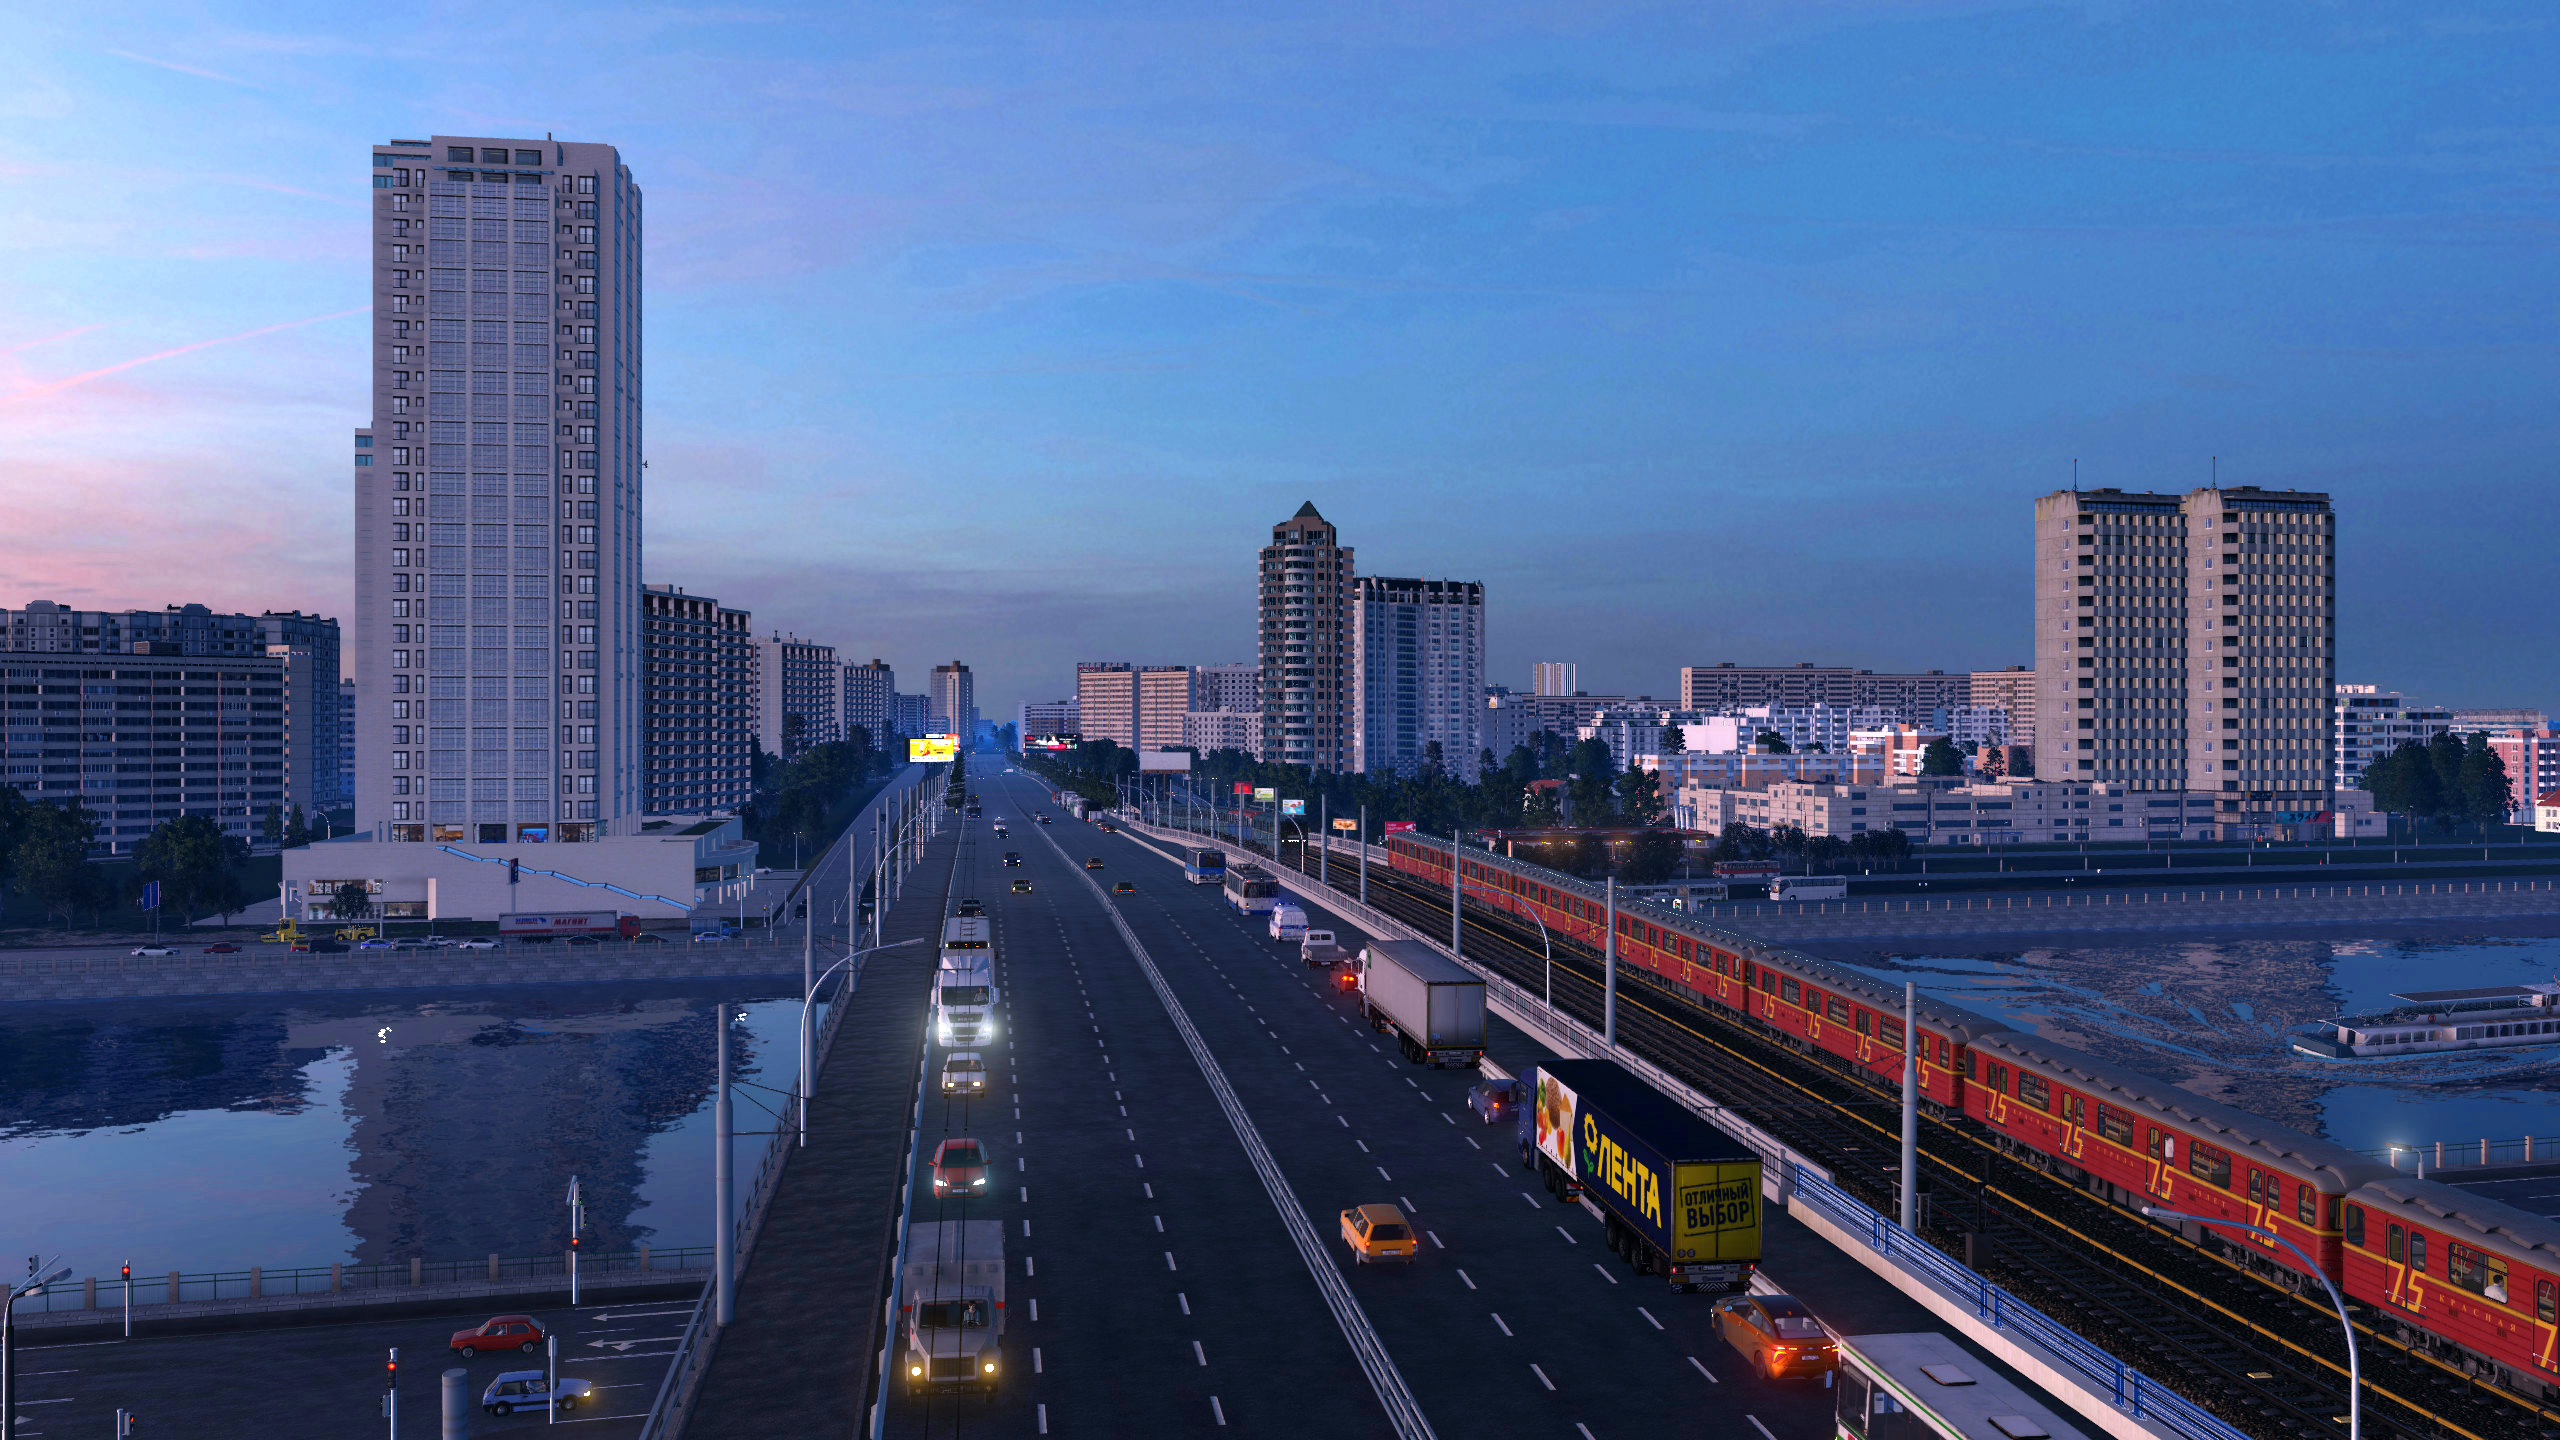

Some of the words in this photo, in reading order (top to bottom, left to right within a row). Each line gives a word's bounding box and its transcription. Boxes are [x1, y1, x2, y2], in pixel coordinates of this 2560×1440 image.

[553, 917, 588, 926] МАГНИТ
[1763, 992, 1775, 1019] 75
[1806, 1011, 1821, 1039] 75
[1856, 1030, 1872, 1063] 75
[1987, 1088, 2007, 1124] 75
[2062, 1119, 2084, 1159] 75
[1597, 1133, 1662, 1229] ЛЕНТА
[1685, 1182, 1749, 1207] ОТЛИЧНЫЙ
[2147, 1156, 2173, 1200] 75
[1687, 1201, 1749, 1229] ВЫБОР
[2247, 1200, 2278, 1249] 75
[2387, 1258, 2424, 1314] 75
[2439, 1293, 2516, 1332] КРАСНАЯ
